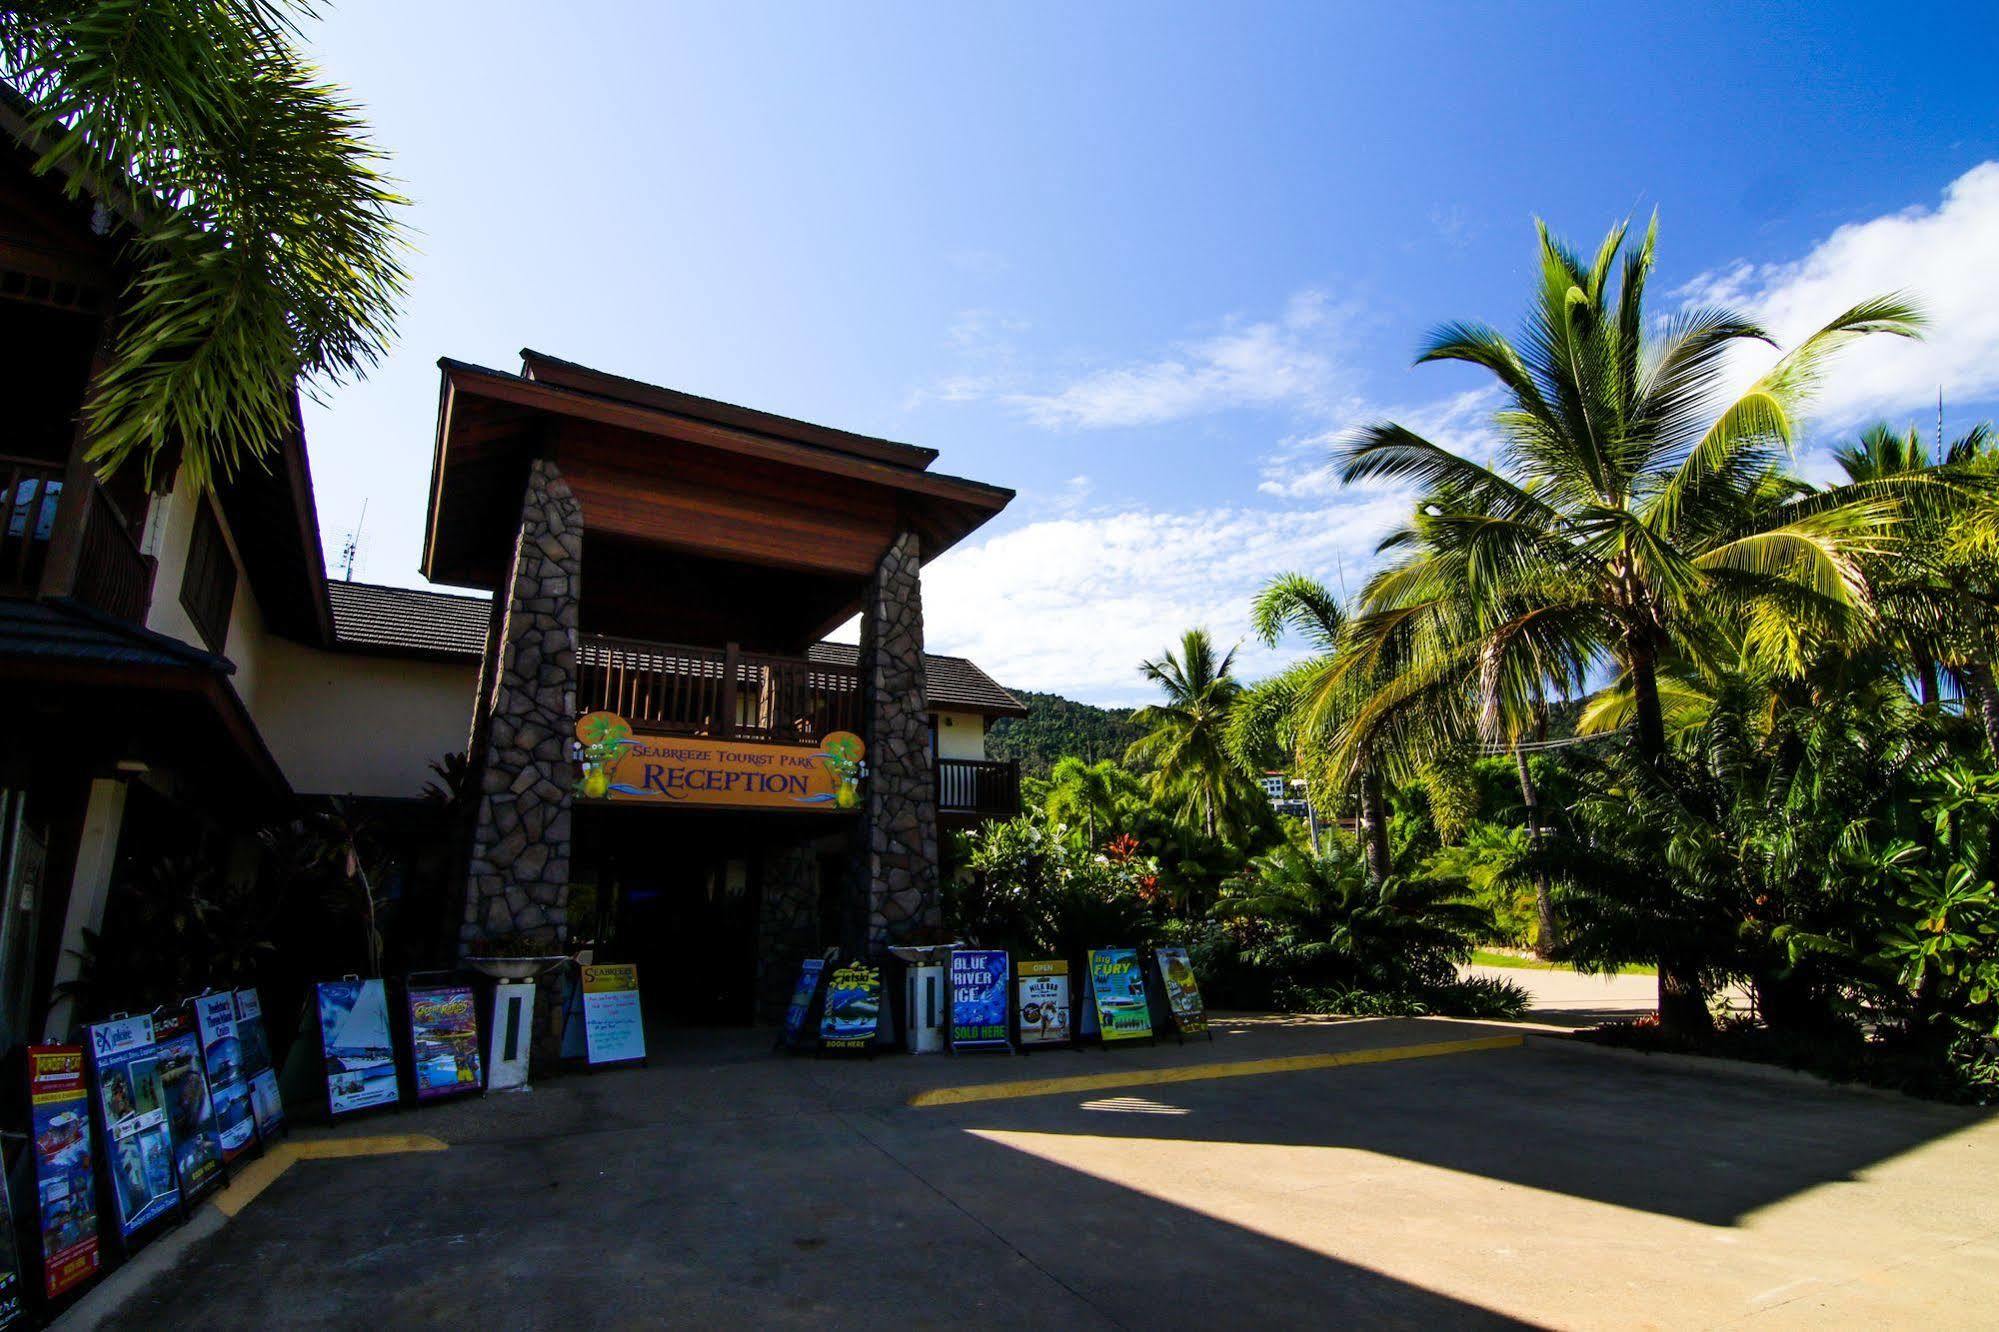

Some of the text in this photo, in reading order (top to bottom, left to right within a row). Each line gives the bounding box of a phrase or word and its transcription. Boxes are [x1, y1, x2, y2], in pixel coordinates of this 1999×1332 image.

[632, 745, 816, 769] SEABREEZE TOURIST PARK
[643, 764, 809, 800] RECEPTION
[954, 956, 988, 970] BLUE
[1034, 964, 1053, 972] OPEN
[1095, 962, 1131, 976] FURY
[842, 972, 869, 983] jetski
[954, 971, 992, 985] RIVER
[954, 987, 979, 1003] ICE
[954, 1025, 1006, 1040] SOLD HERE
[825, 1040, 865, 1048] BOOK HERE
